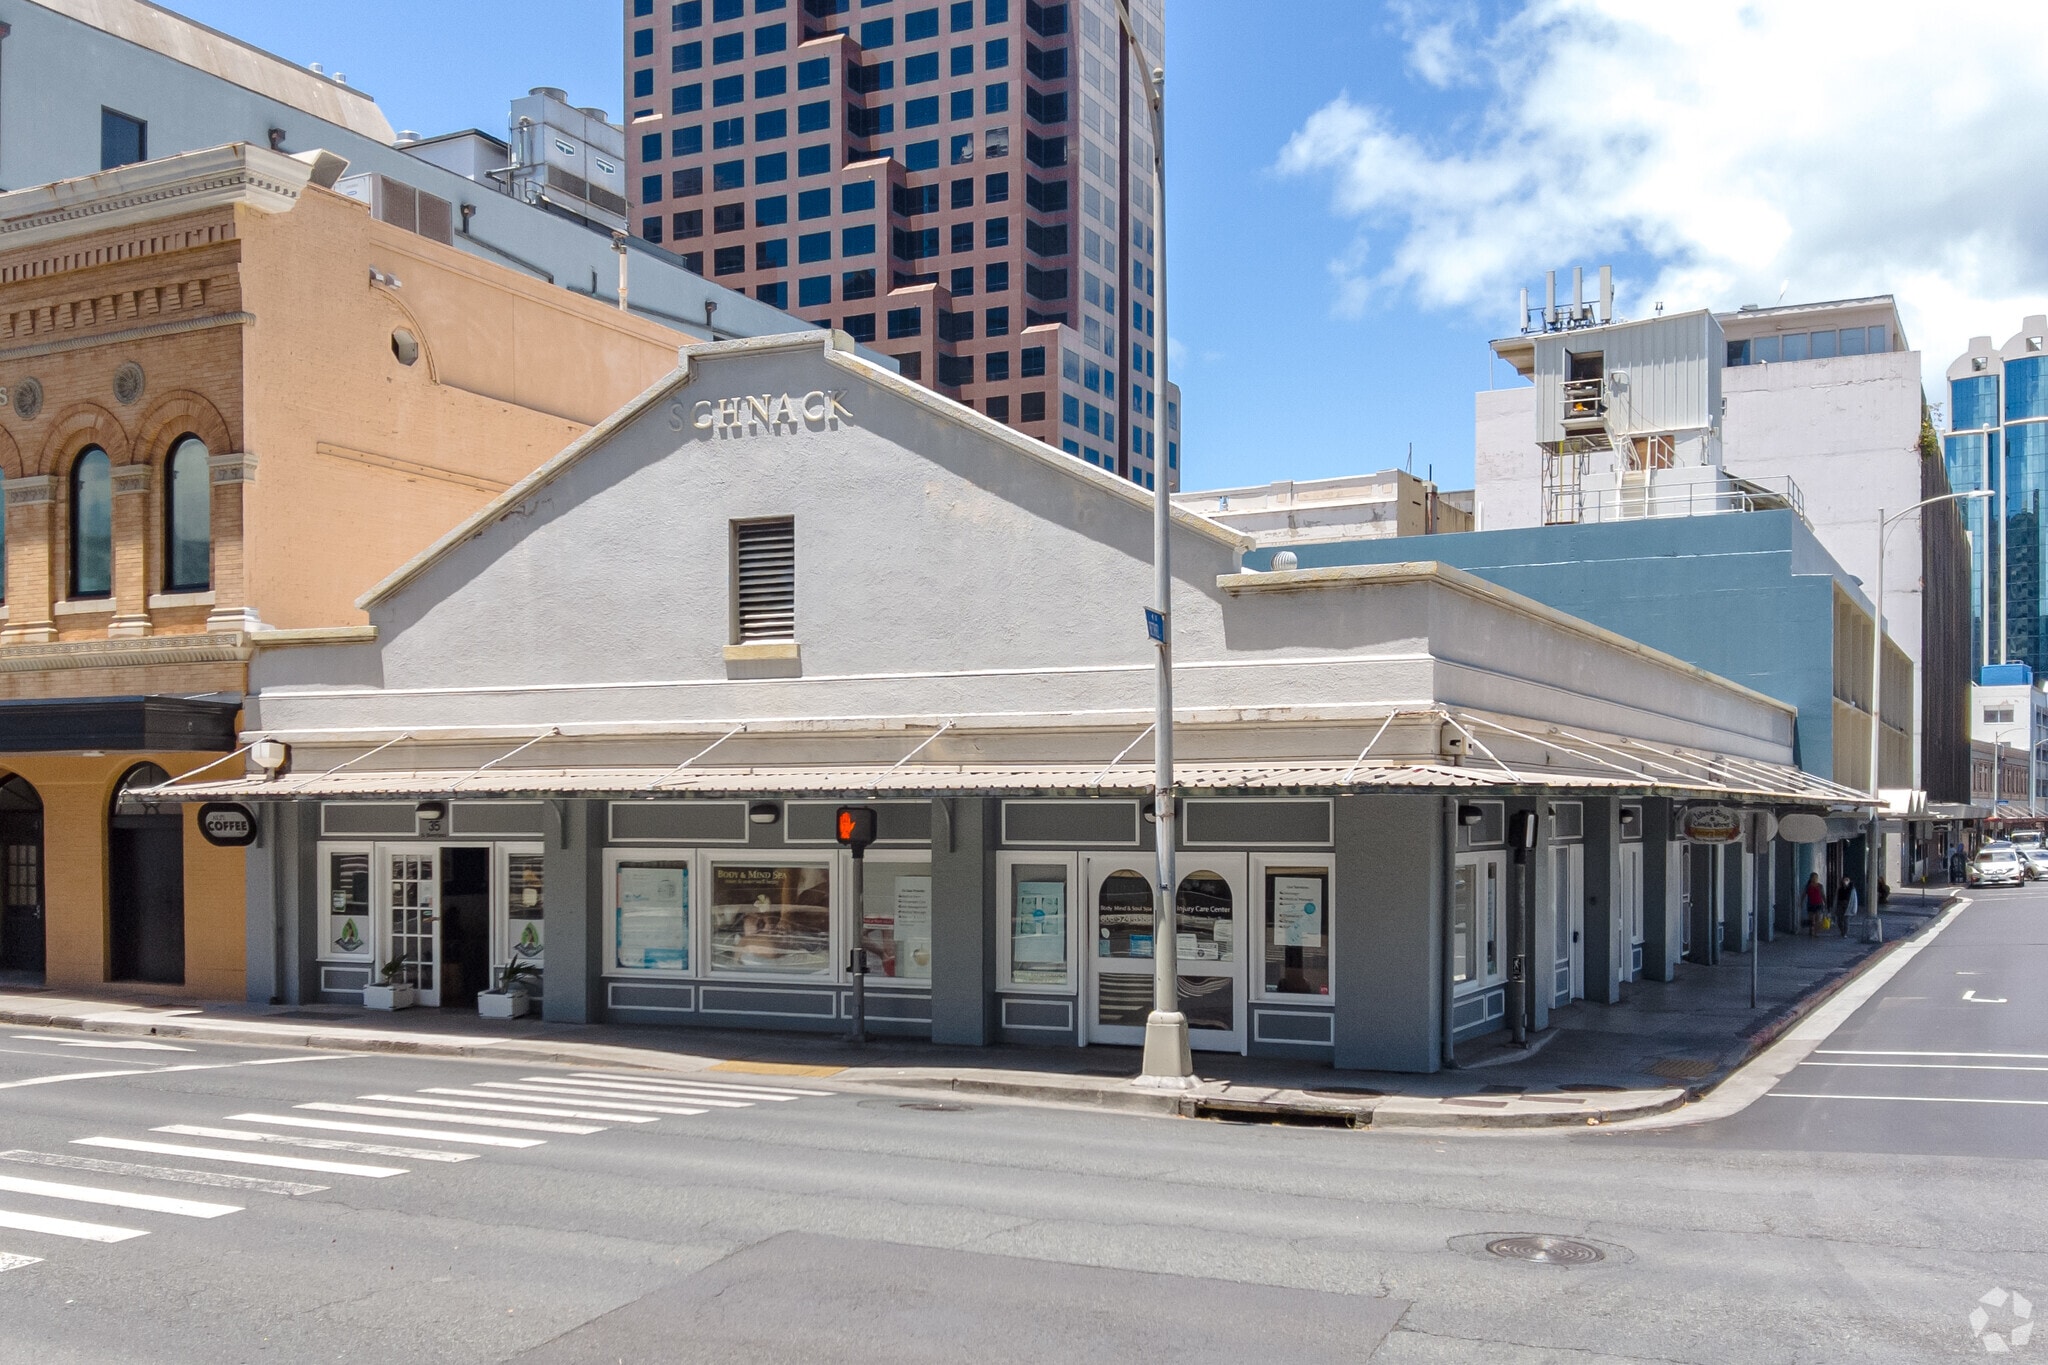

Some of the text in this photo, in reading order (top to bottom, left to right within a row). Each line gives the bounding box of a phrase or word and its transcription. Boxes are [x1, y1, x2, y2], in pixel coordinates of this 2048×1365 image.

[669, 389, 854, 432] SCHNACK
[207, 820, 248, 832] COFFEE
[428, 820, 441, 831] 35
[1177, 905, 1194, 913] Injury
